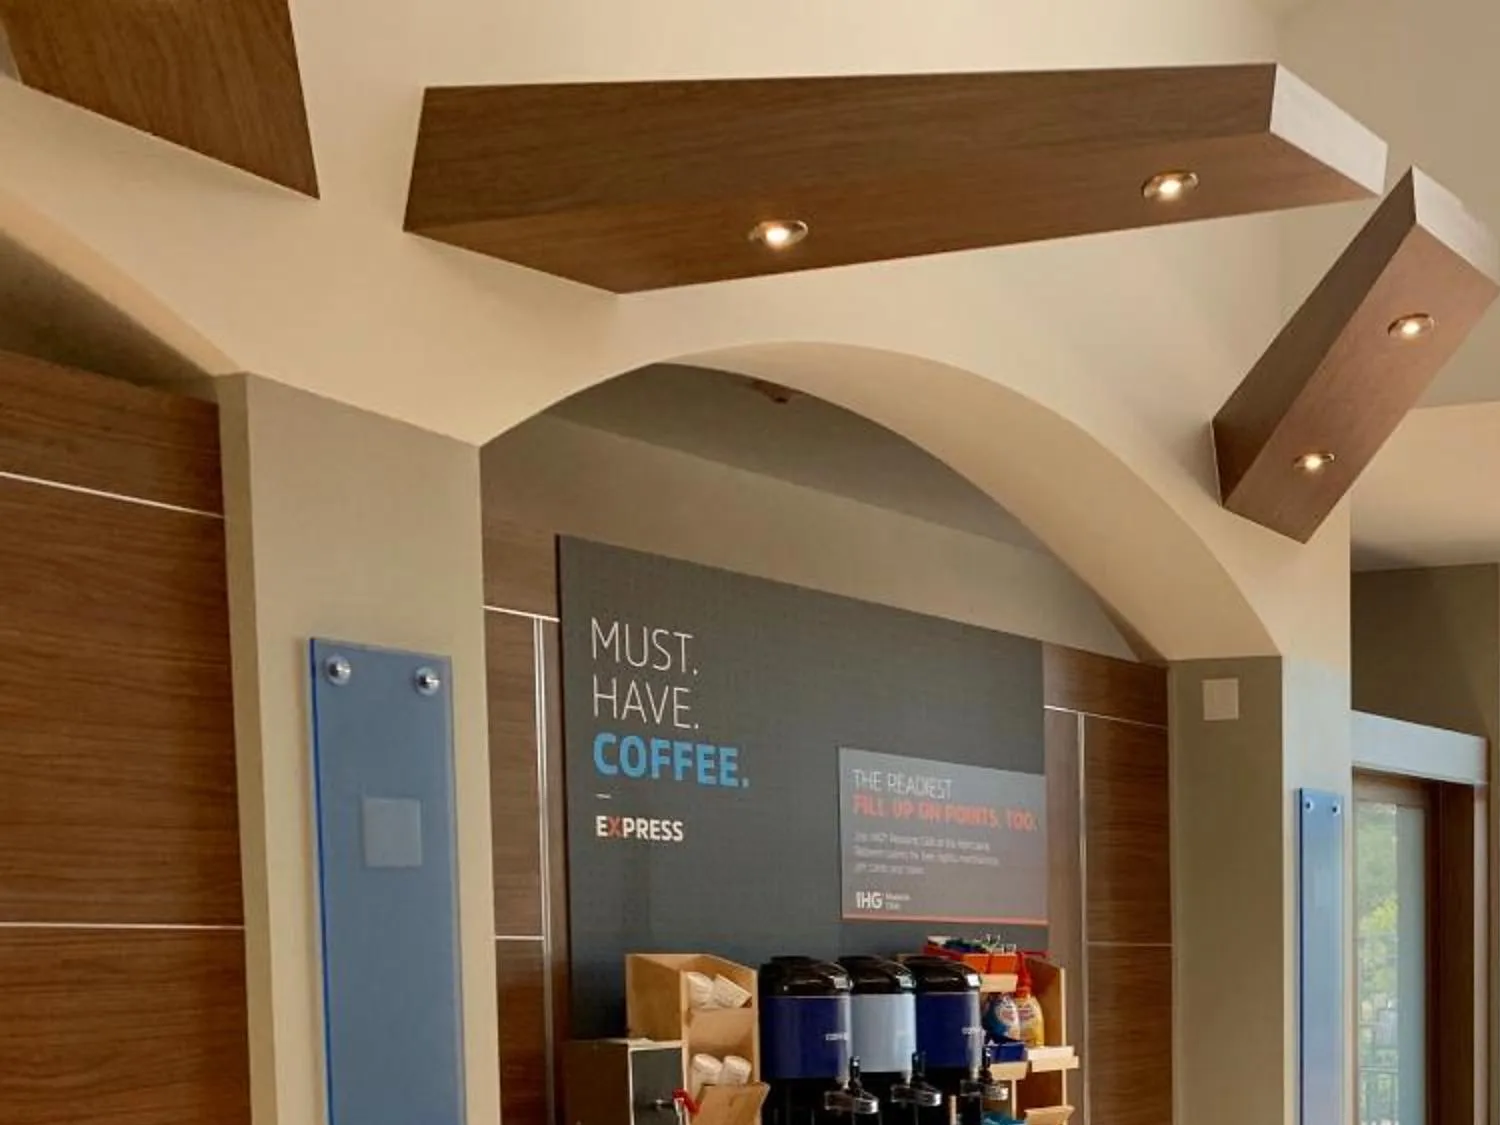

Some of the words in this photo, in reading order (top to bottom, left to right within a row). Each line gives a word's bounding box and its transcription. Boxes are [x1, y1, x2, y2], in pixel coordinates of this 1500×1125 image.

[591, 616, 698, 676] MUST.
[593, 674, 699, 729] HAVE.
[593, 732, 749, 788] COFFEE.
[852, 769, 882, 792] THE
[887, 772, 953, 799] READIEST
[892, 797, 915, 821] UP
[595, 815, 684, 843] EXPRESS
[855, 891, 883, 909] IHG
